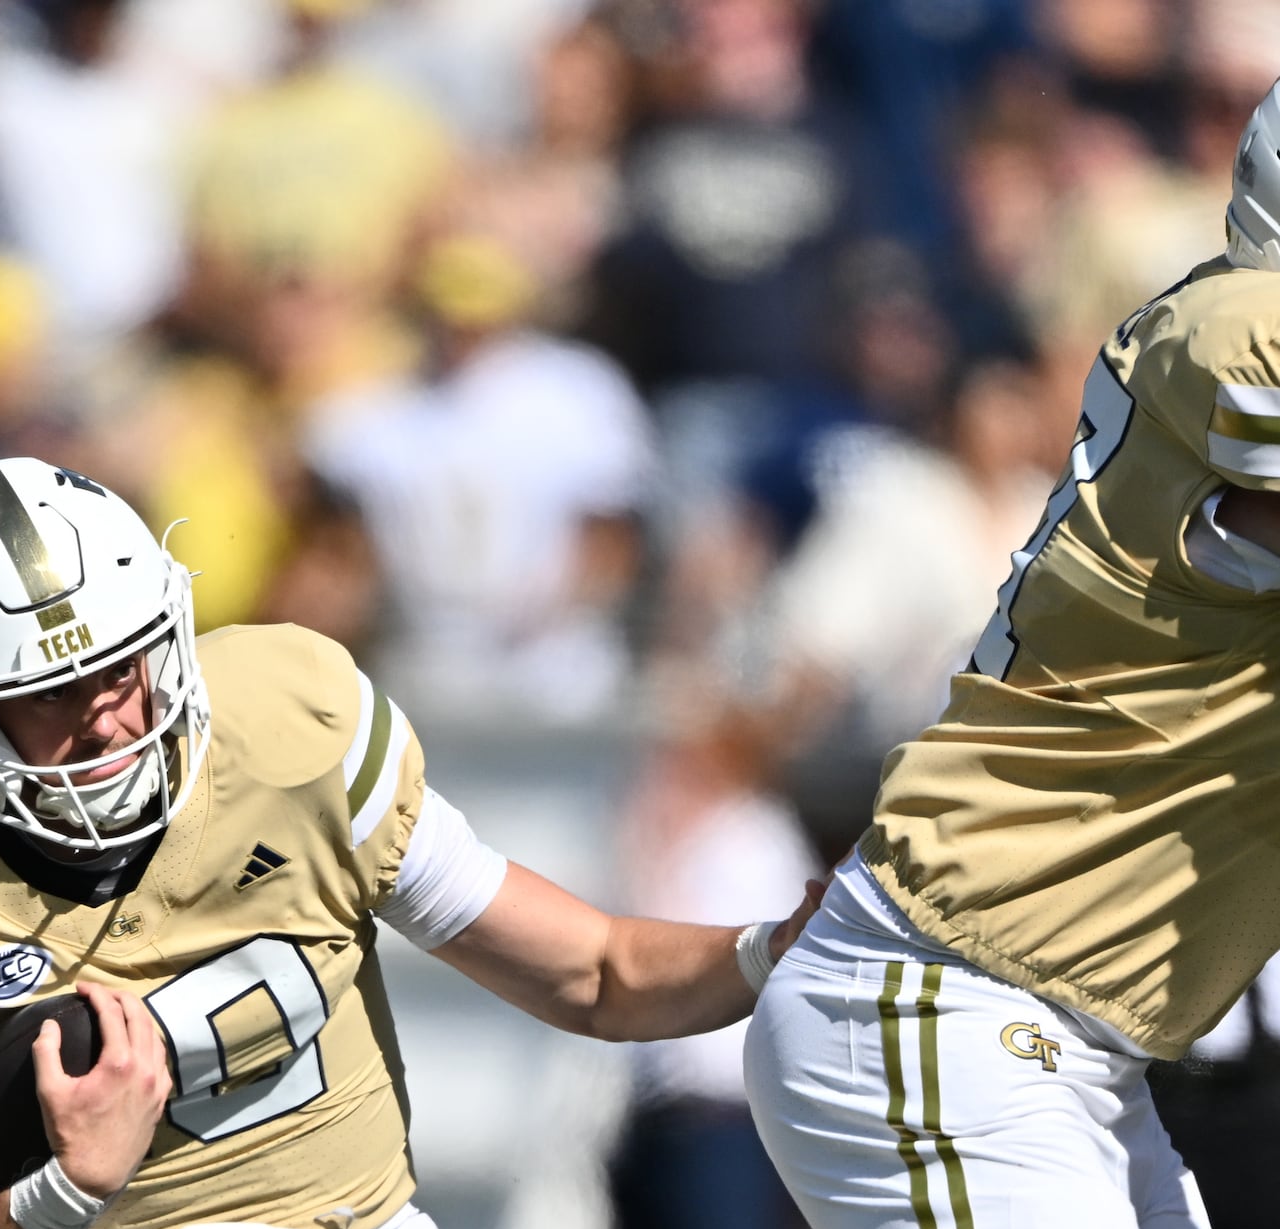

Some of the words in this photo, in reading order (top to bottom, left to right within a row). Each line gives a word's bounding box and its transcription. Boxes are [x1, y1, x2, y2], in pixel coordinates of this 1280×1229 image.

[38, 623, 94, 663] TECH
[142, 932, 329, 1144] 0
[1000, 1022, 1061, 1073] GT
